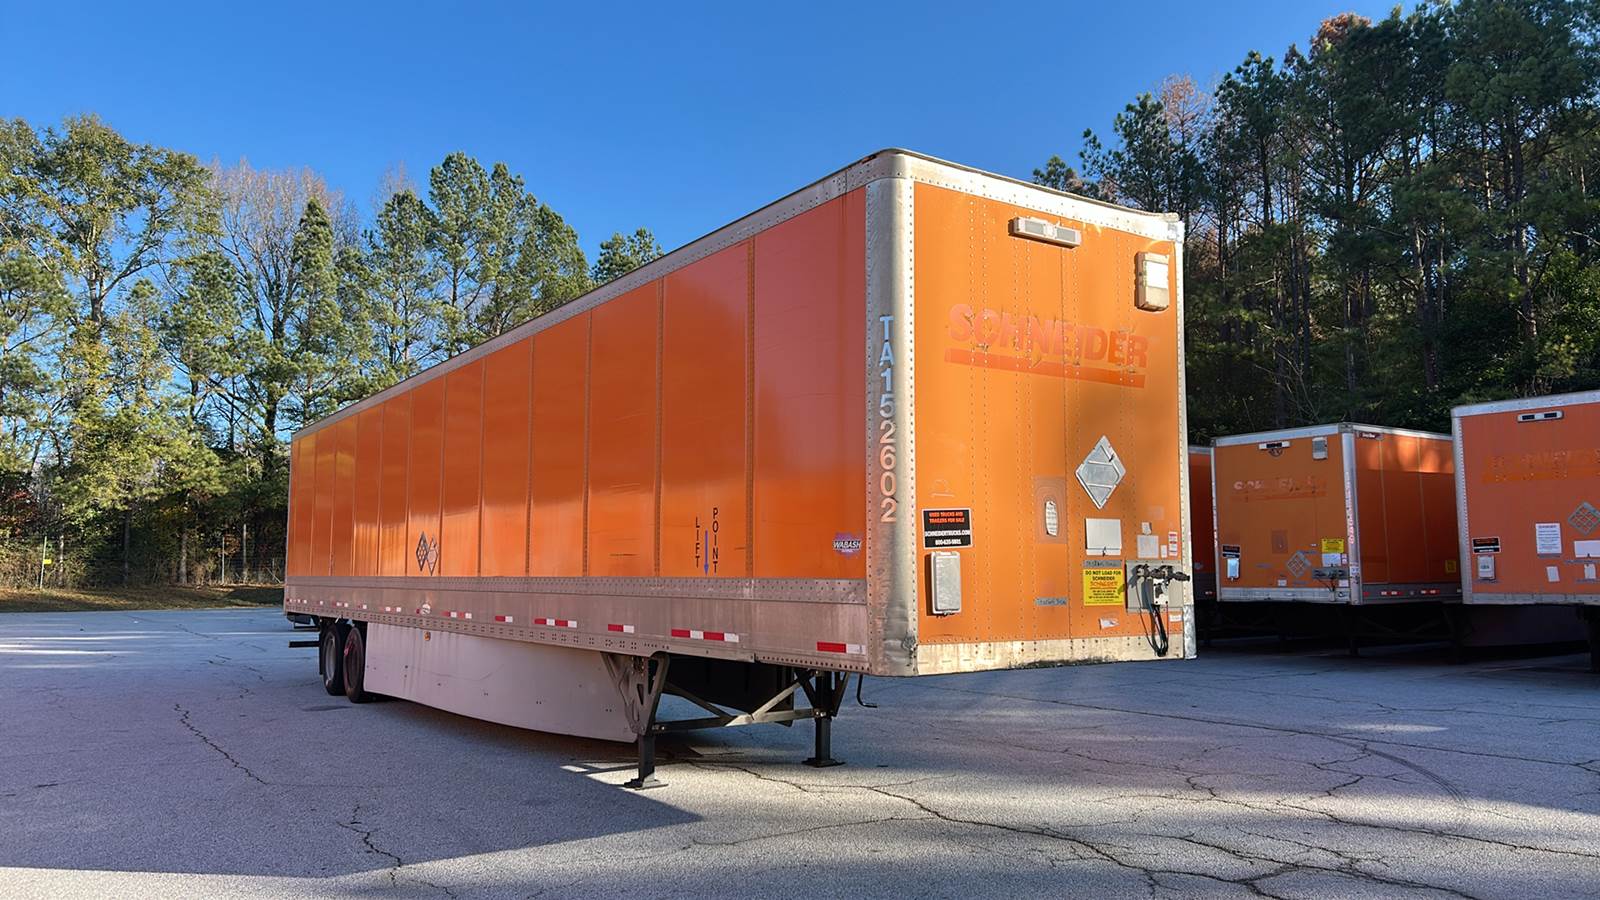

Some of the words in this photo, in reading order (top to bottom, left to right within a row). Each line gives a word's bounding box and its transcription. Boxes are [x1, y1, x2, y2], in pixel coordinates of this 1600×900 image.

[949, 303, 1149, 368] SCHNEIDER
[879, 316, 897, 523] TA152602
[833, 540, 862, 549] WABASH
